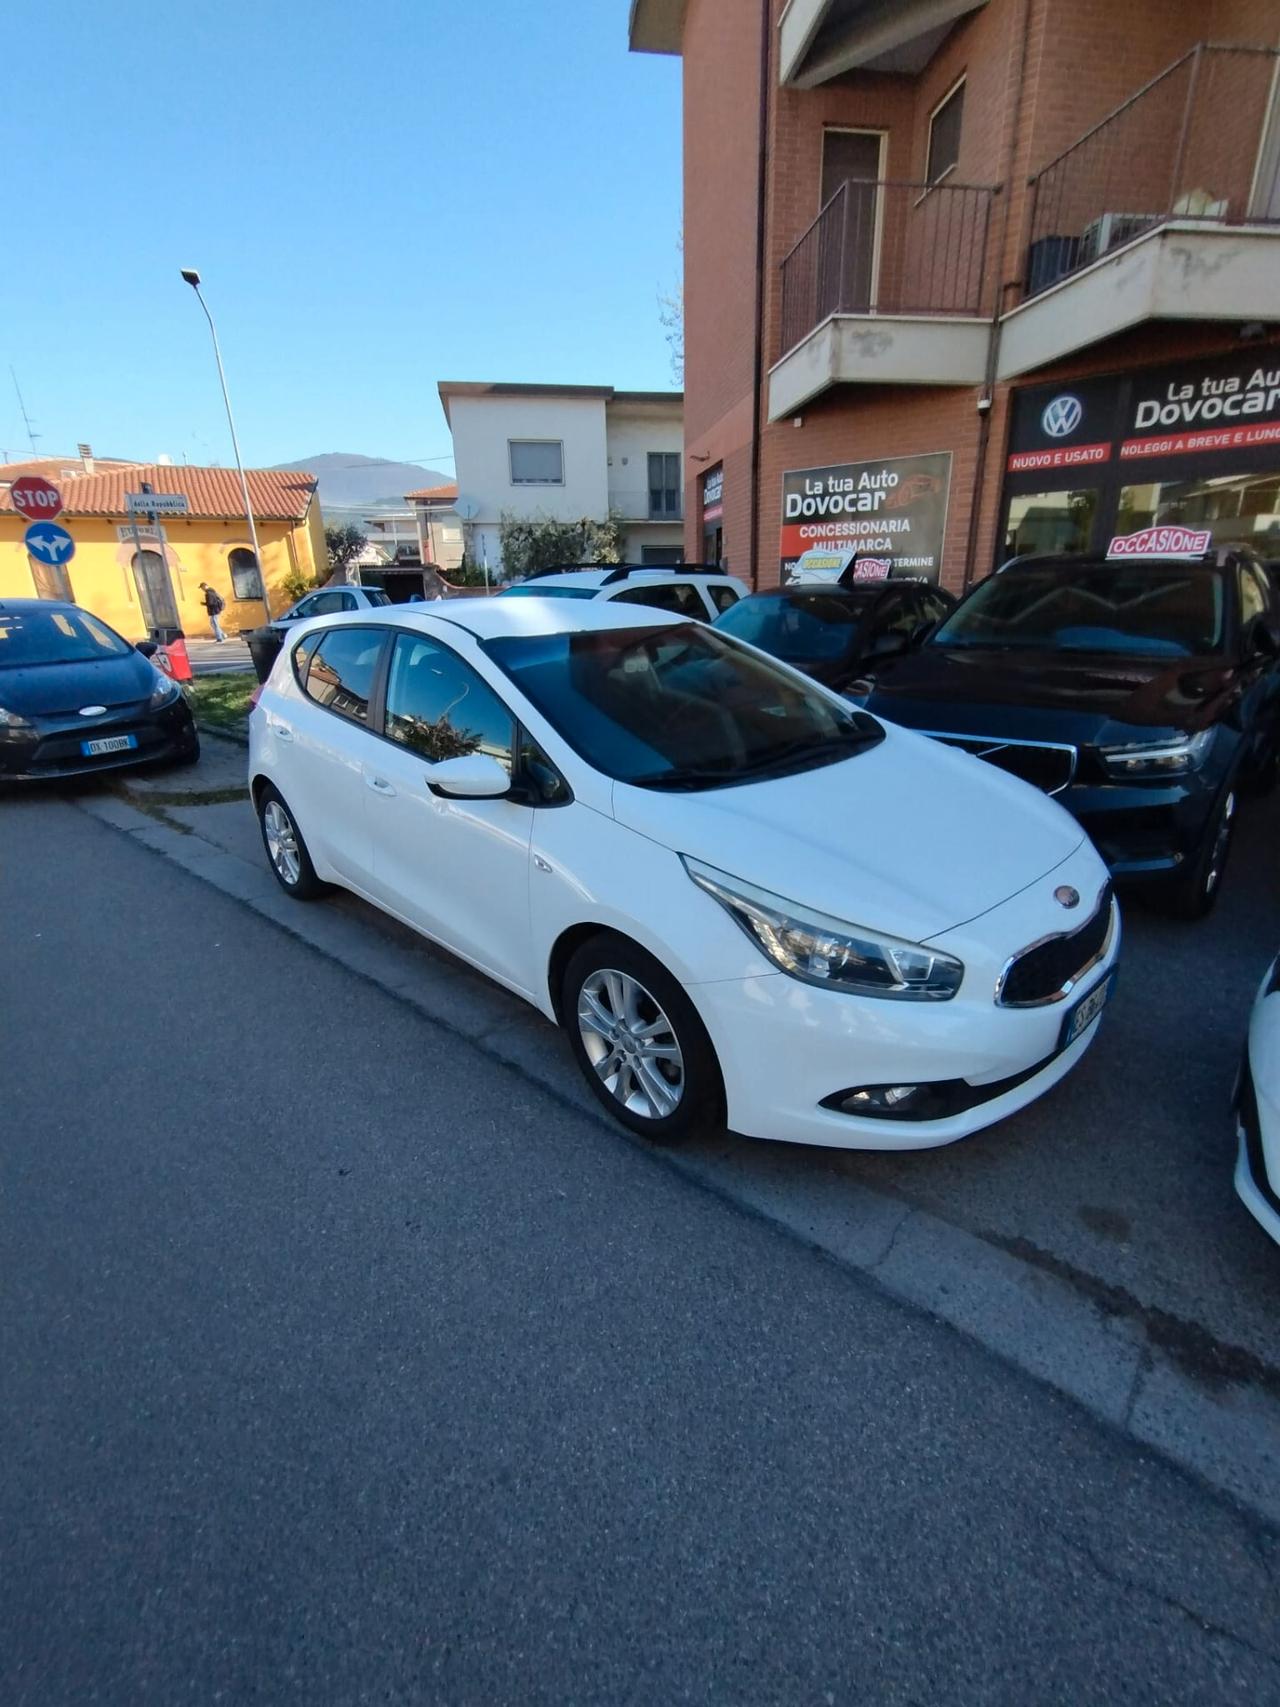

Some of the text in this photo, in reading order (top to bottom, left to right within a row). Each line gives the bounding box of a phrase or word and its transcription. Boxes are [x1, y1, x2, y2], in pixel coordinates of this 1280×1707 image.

[1168, 382, 1194, 401] La
[1201, 377, 1240, 396] tua
[1135, 388, 1280, 429] Dovocar
[1120, 441, 1172, 457] NOLEGGI
[1174, 440, 1184, 450] A
[1187, 433, 1231, 449] BREVE
[1234, 432, 1244, 443] E
[1012, 448, 1104, 469] NUOVO E USATO
[805, 470, 898, 495] La tua Auto
[13, 490, 58, 507] STOP
[786, 491, 886, 518] Dovocar
[800, 519, 911, 538] CONCESSIONARIA
[812, 538, 893, 552] MULTIMARCA
[1113, 530, 1205, 553] OCCASIONE
[893, 557, 934, 568] TERMINE
